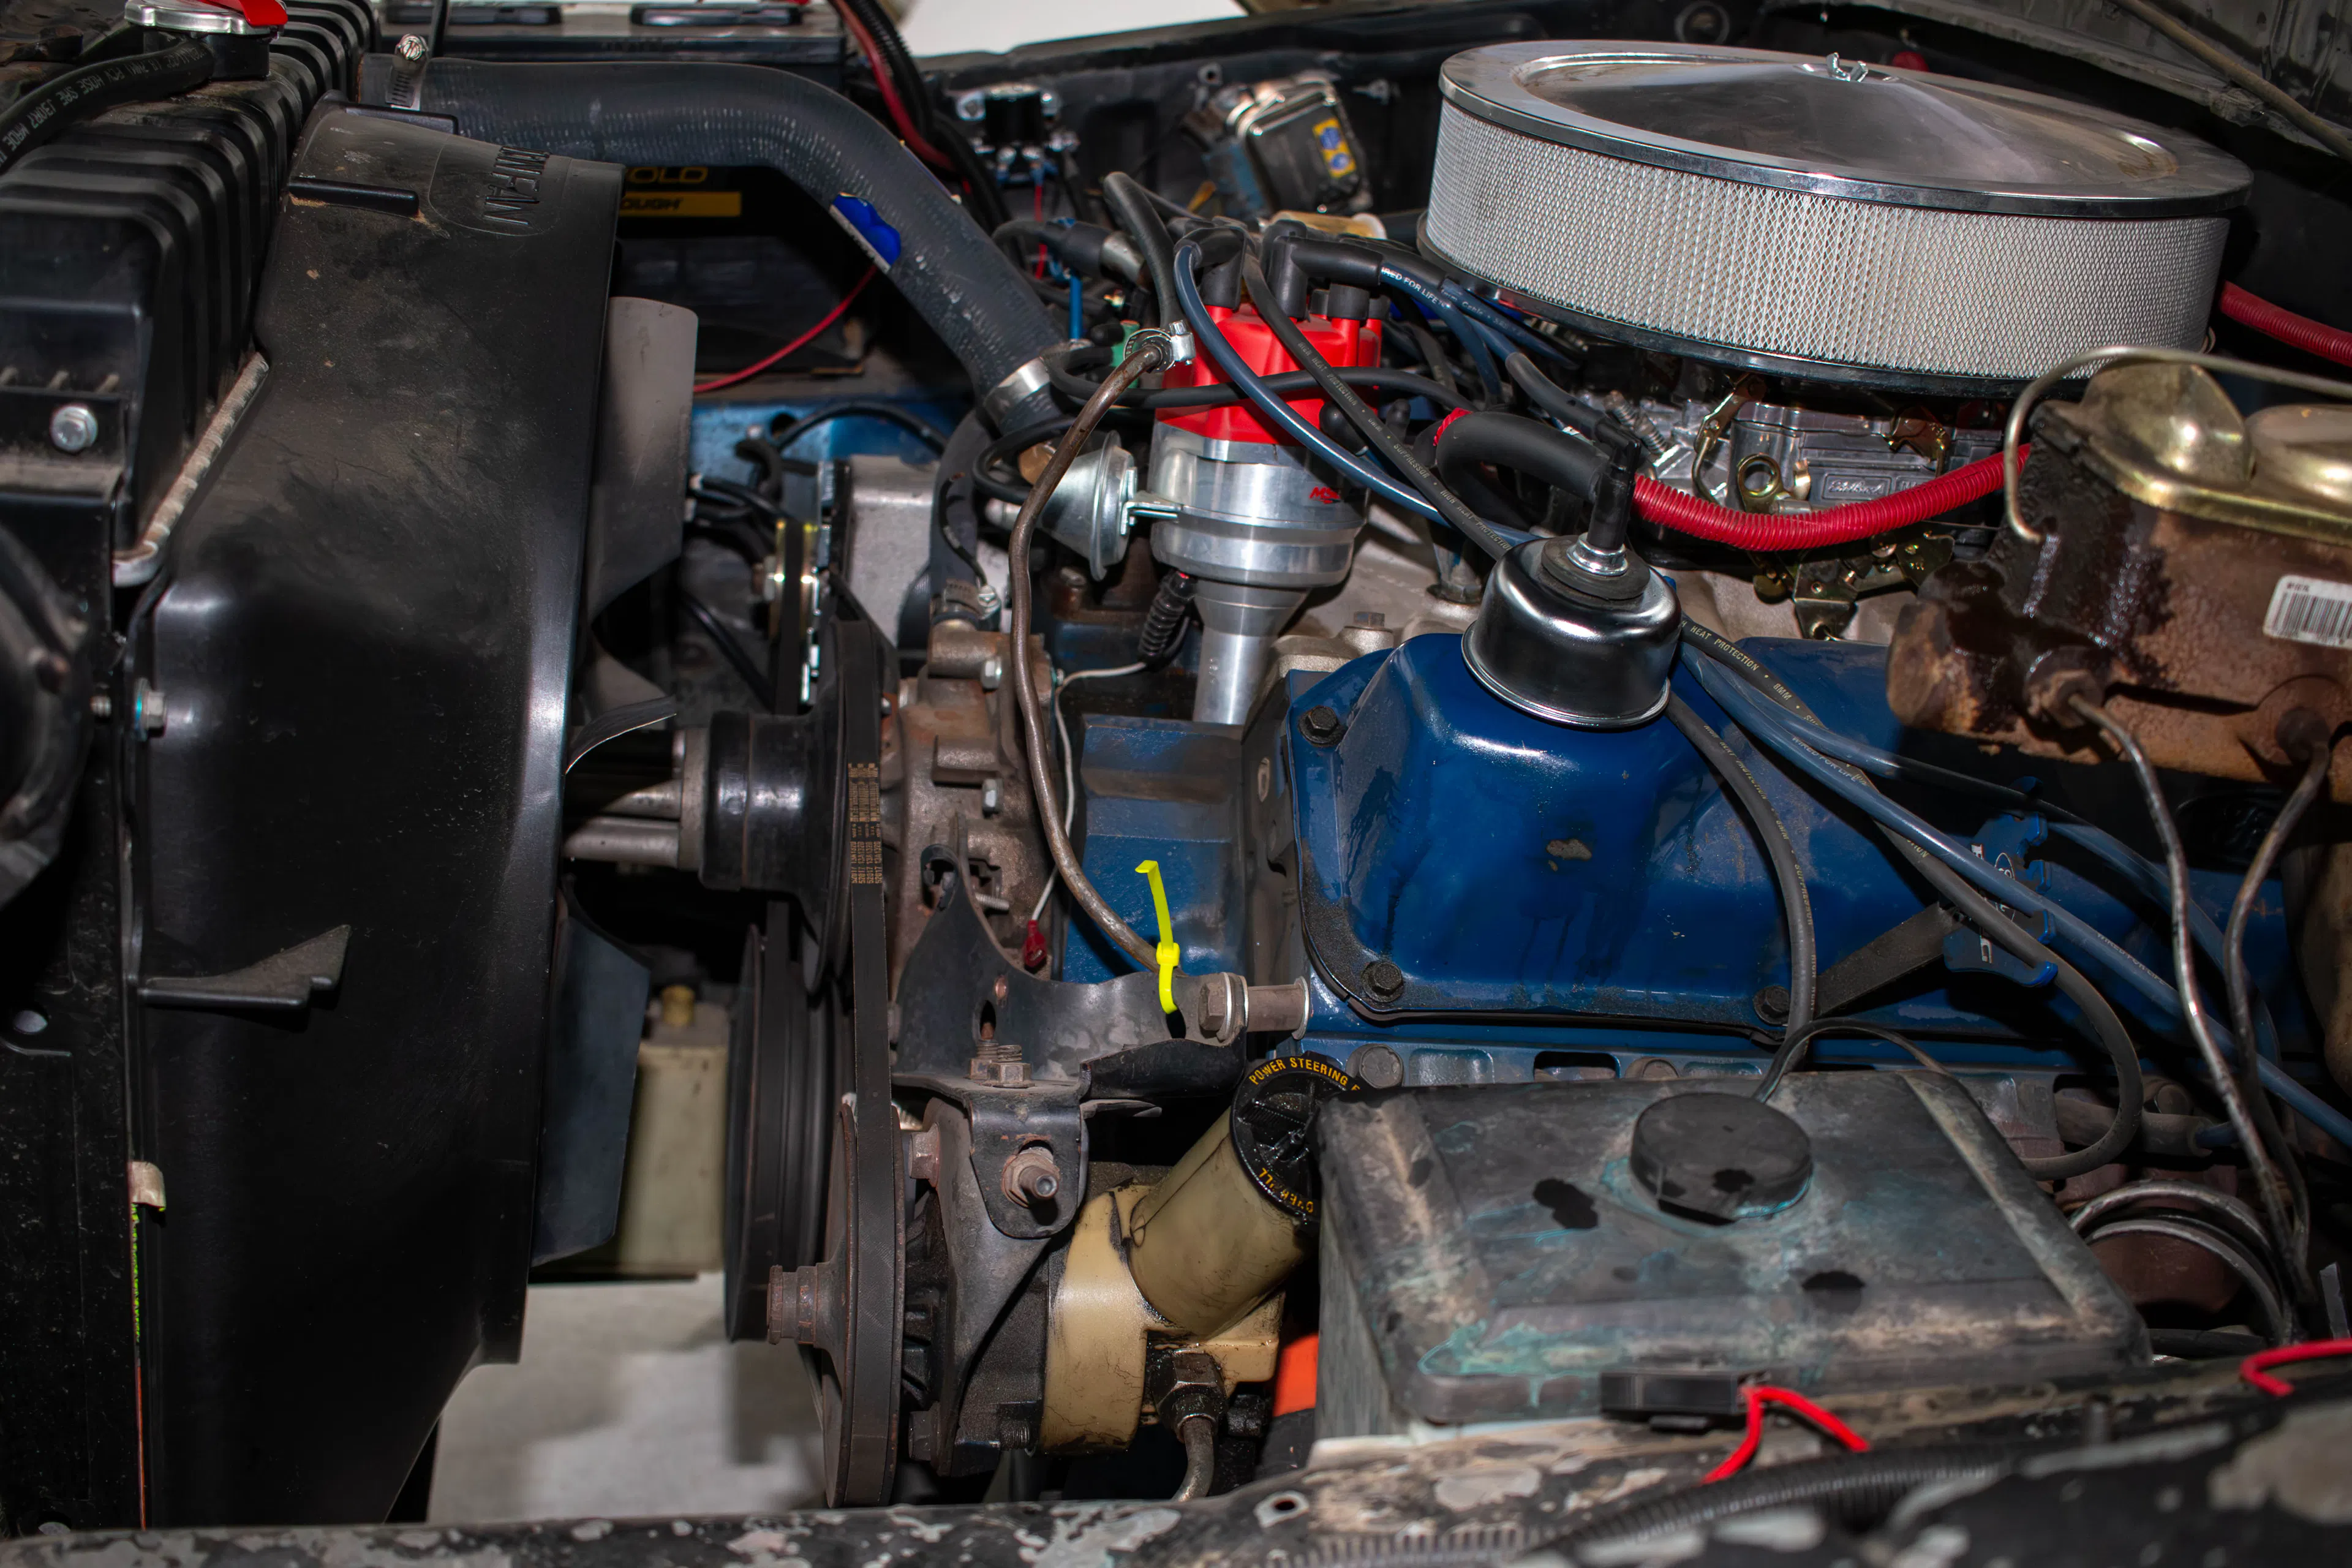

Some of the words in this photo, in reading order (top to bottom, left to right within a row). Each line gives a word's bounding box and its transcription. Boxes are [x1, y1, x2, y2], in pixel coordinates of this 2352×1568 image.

[56, 85, 79, 106] SAE
[76, 75, 105, 94] HOSE
[2, 123, 29, 152] MADE
[627, 166, 709, 184] OLD
[1381, 266, 1402, 281] IRED
[1403, 276, 1421, 292] FOR
[1311, 357, 1328, 372] HEAT
[1326, 373, 1359, 406] PROTECTION
[1393, 443, 1431, 479] SUPPRESSOR
[1439, 489, 1457, 505] HIGH
[1457, 506, 1476, 520] HEAT
[1690, 625, 1712, 641] HEAT
[1714, 638, 1760, 672] PROTECTION
[1773, 682, 1793, 701] 8MM
[1792, 736, 1820, 758] WIRED
[1819, 756, 1838, 771] FOR
[1736, 760, 1767, 800] PROTECTION
[1248, 1058, 1287, 1085] POWER
[1289, 1057, 1349, 1086] STEERING
